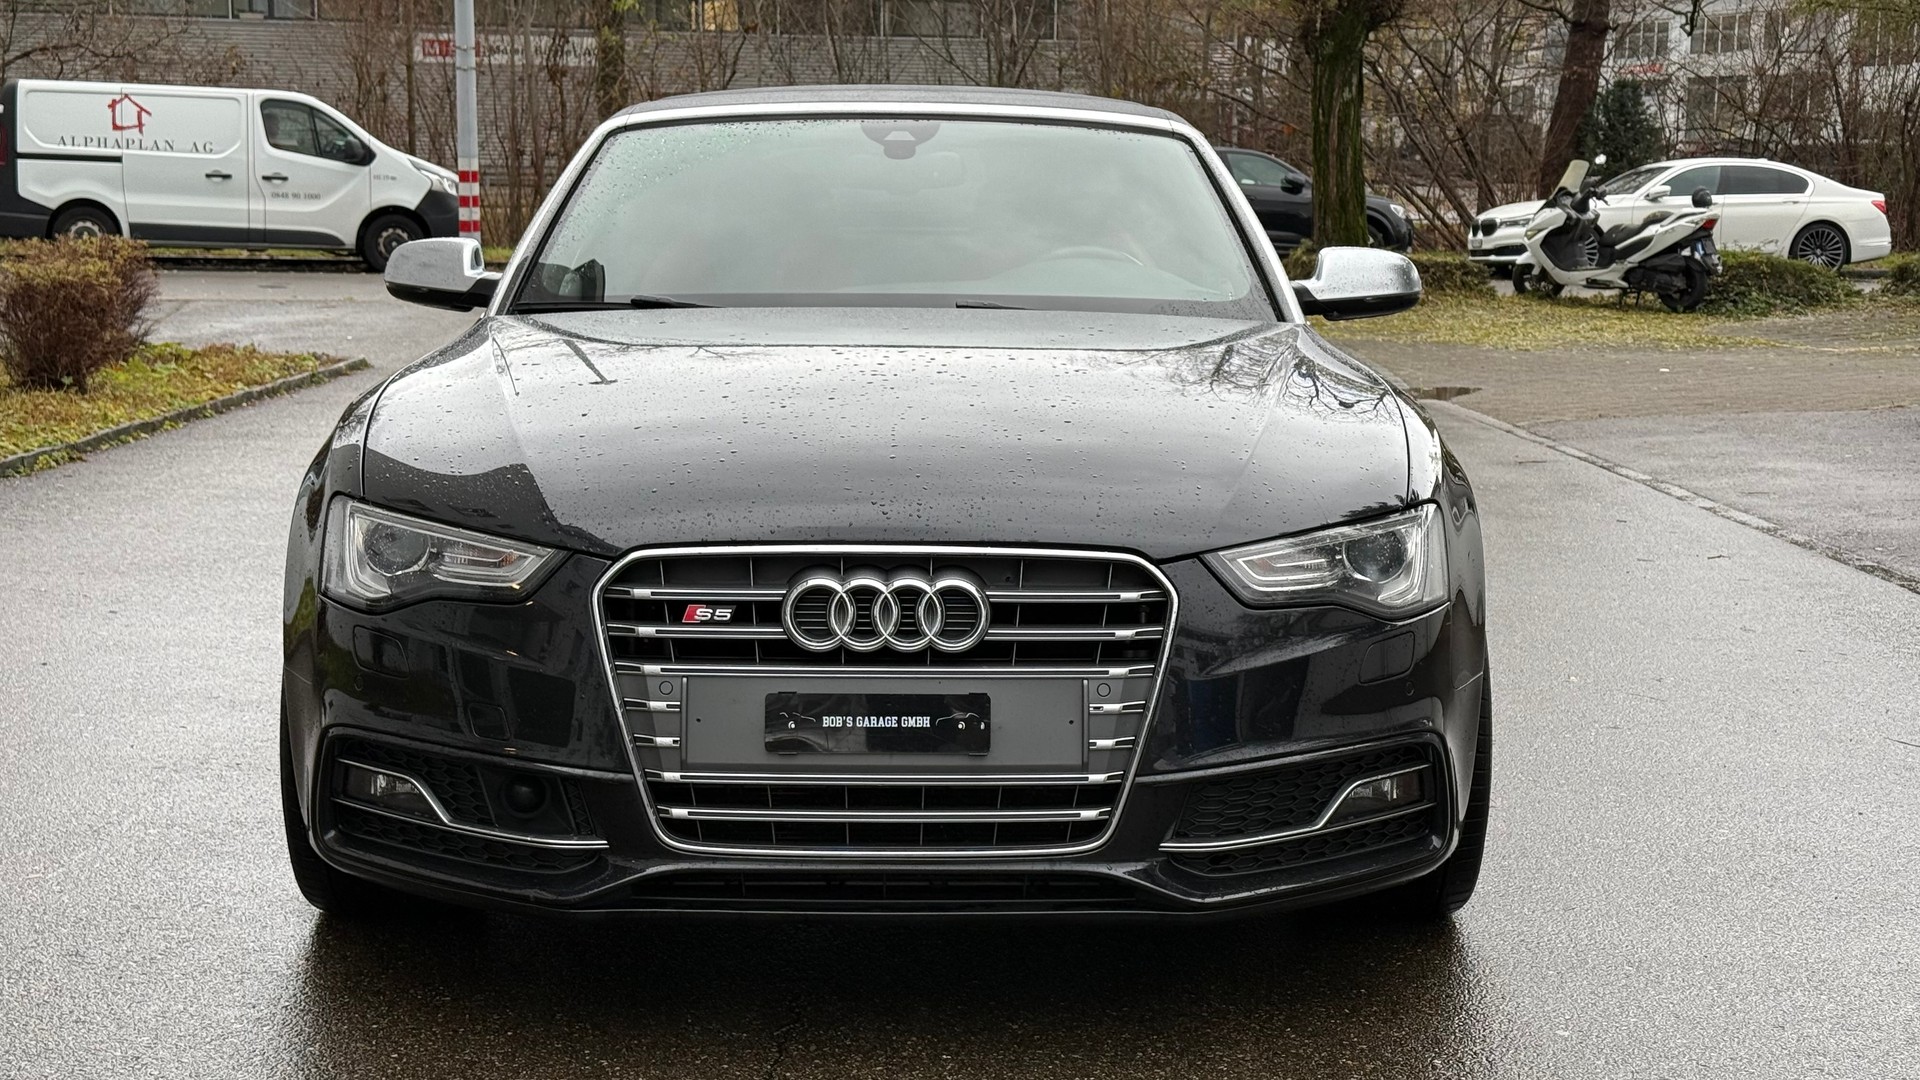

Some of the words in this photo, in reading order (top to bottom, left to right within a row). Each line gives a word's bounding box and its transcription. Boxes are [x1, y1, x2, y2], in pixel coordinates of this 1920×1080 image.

[57, 135, 175, 151] ALPHAPLAN
[191, 141, 214, 154] AG
[694, 608, 733, 621] S5
[822, 716, 853, 728] BOB'S
[856, 716, 898, 728] GARAGE
[901, 716, 931, 728] GMBH
